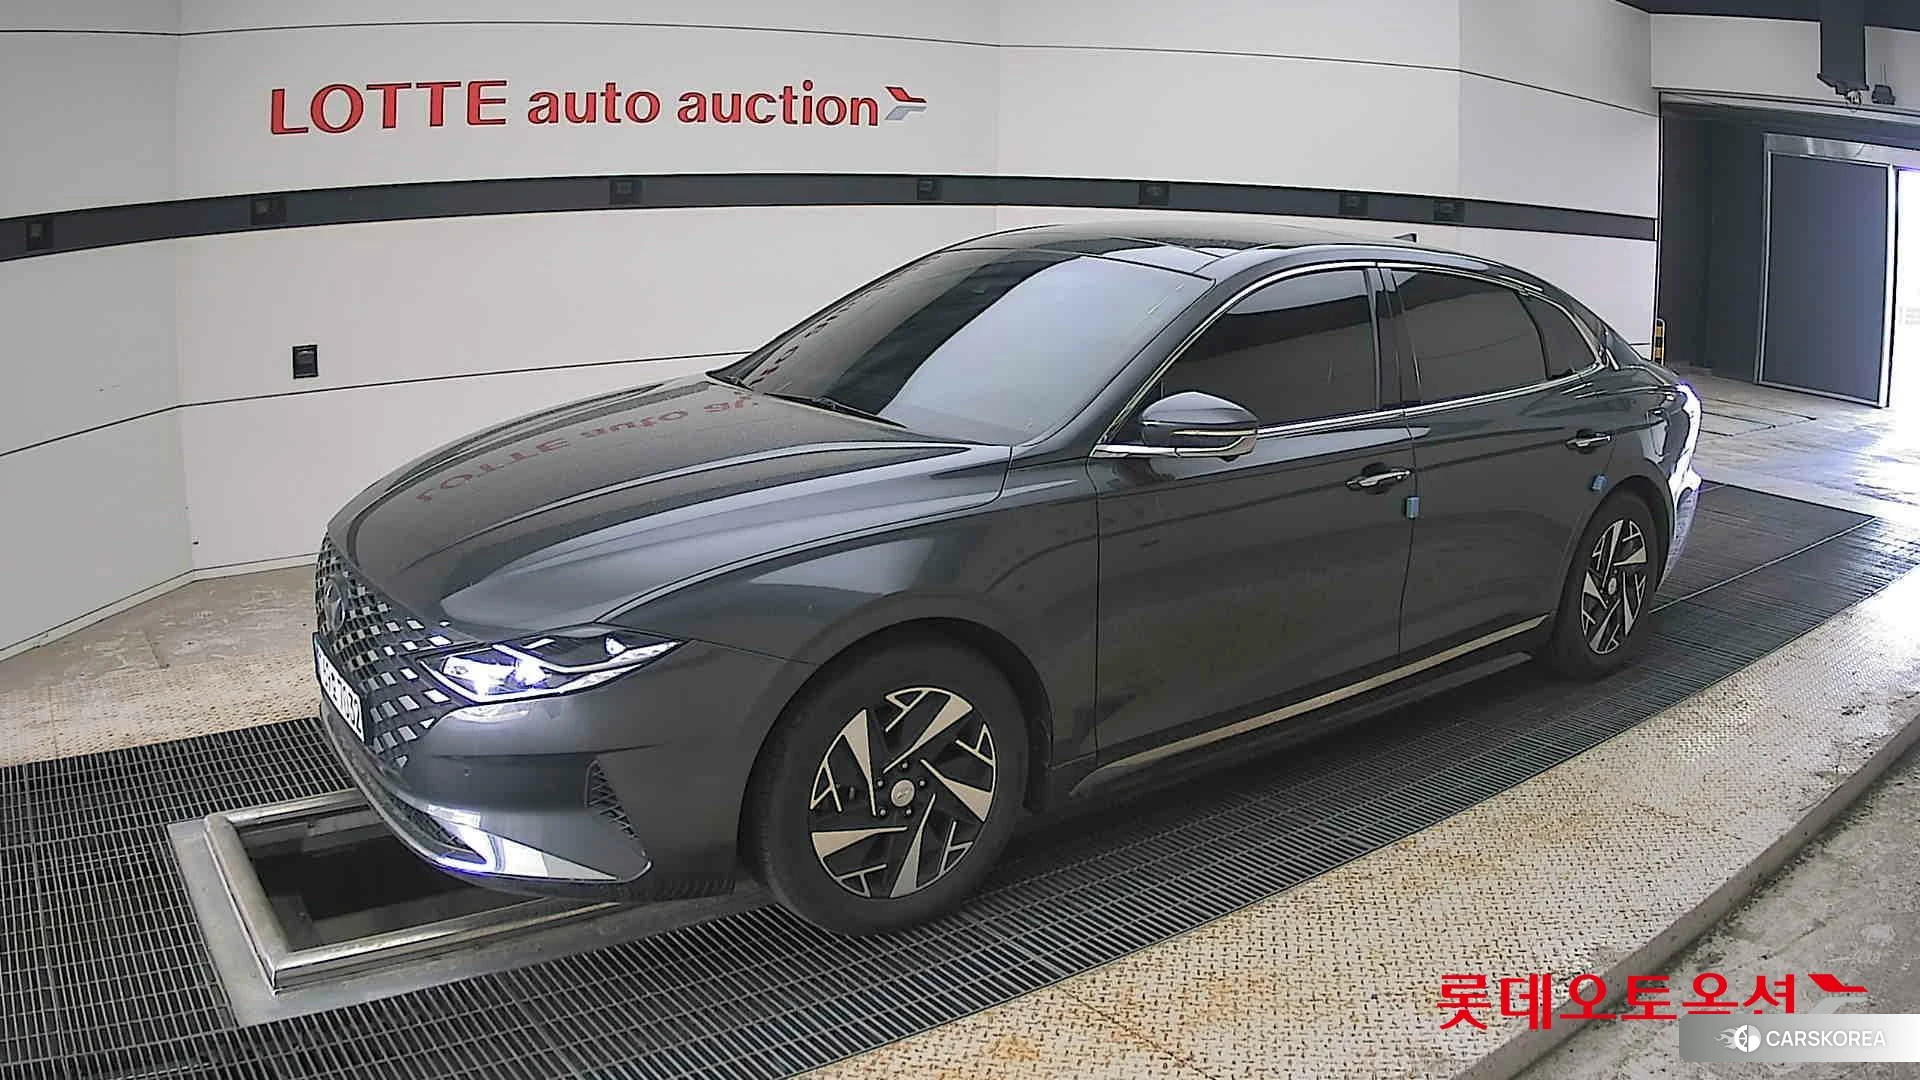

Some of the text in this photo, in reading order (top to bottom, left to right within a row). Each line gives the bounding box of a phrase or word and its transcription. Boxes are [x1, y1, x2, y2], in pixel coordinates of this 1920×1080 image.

[269, 80, 879, 136] LOTTE auto auction
